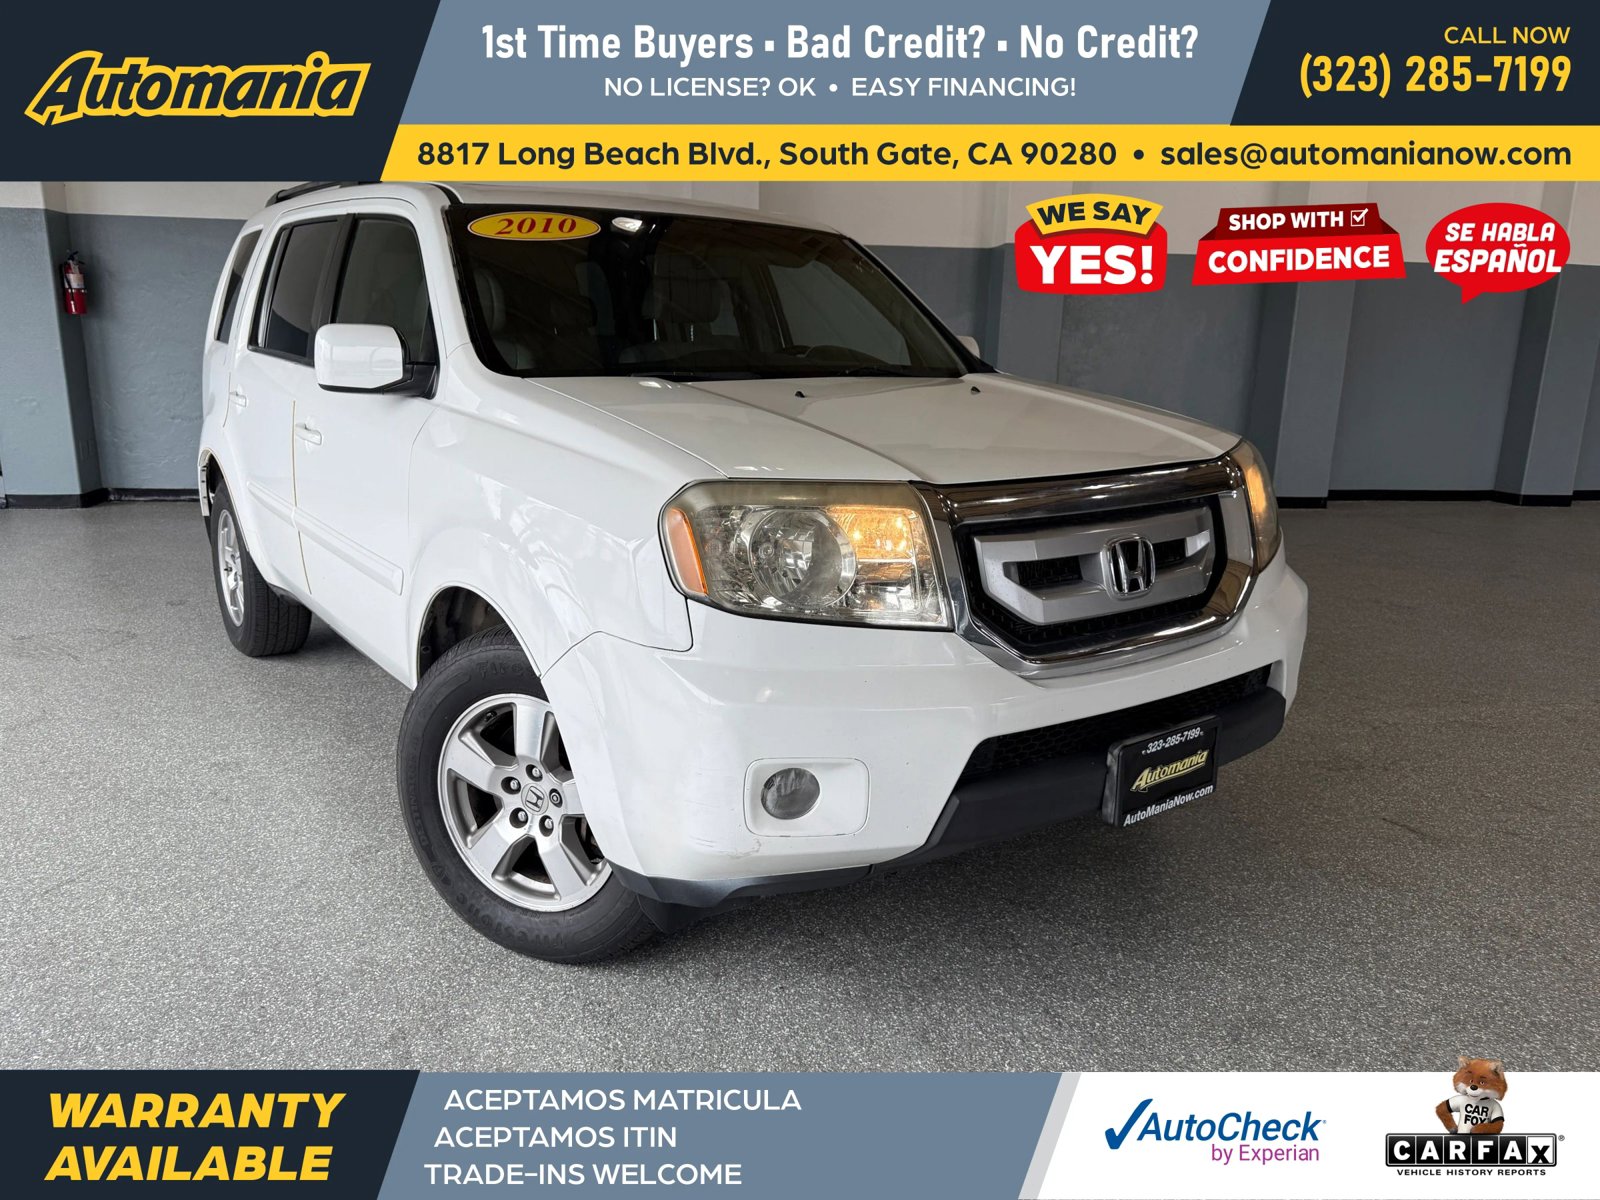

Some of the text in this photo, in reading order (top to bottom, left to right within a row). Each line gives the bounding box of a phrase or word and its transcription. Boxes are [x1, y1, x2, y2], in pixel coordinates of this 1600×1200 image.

[495, 217, 577, 235] 2010
[1130, 749, 1209, 792] Automania
[1123, 785, 1213, 827] AutoManiaNow.com
